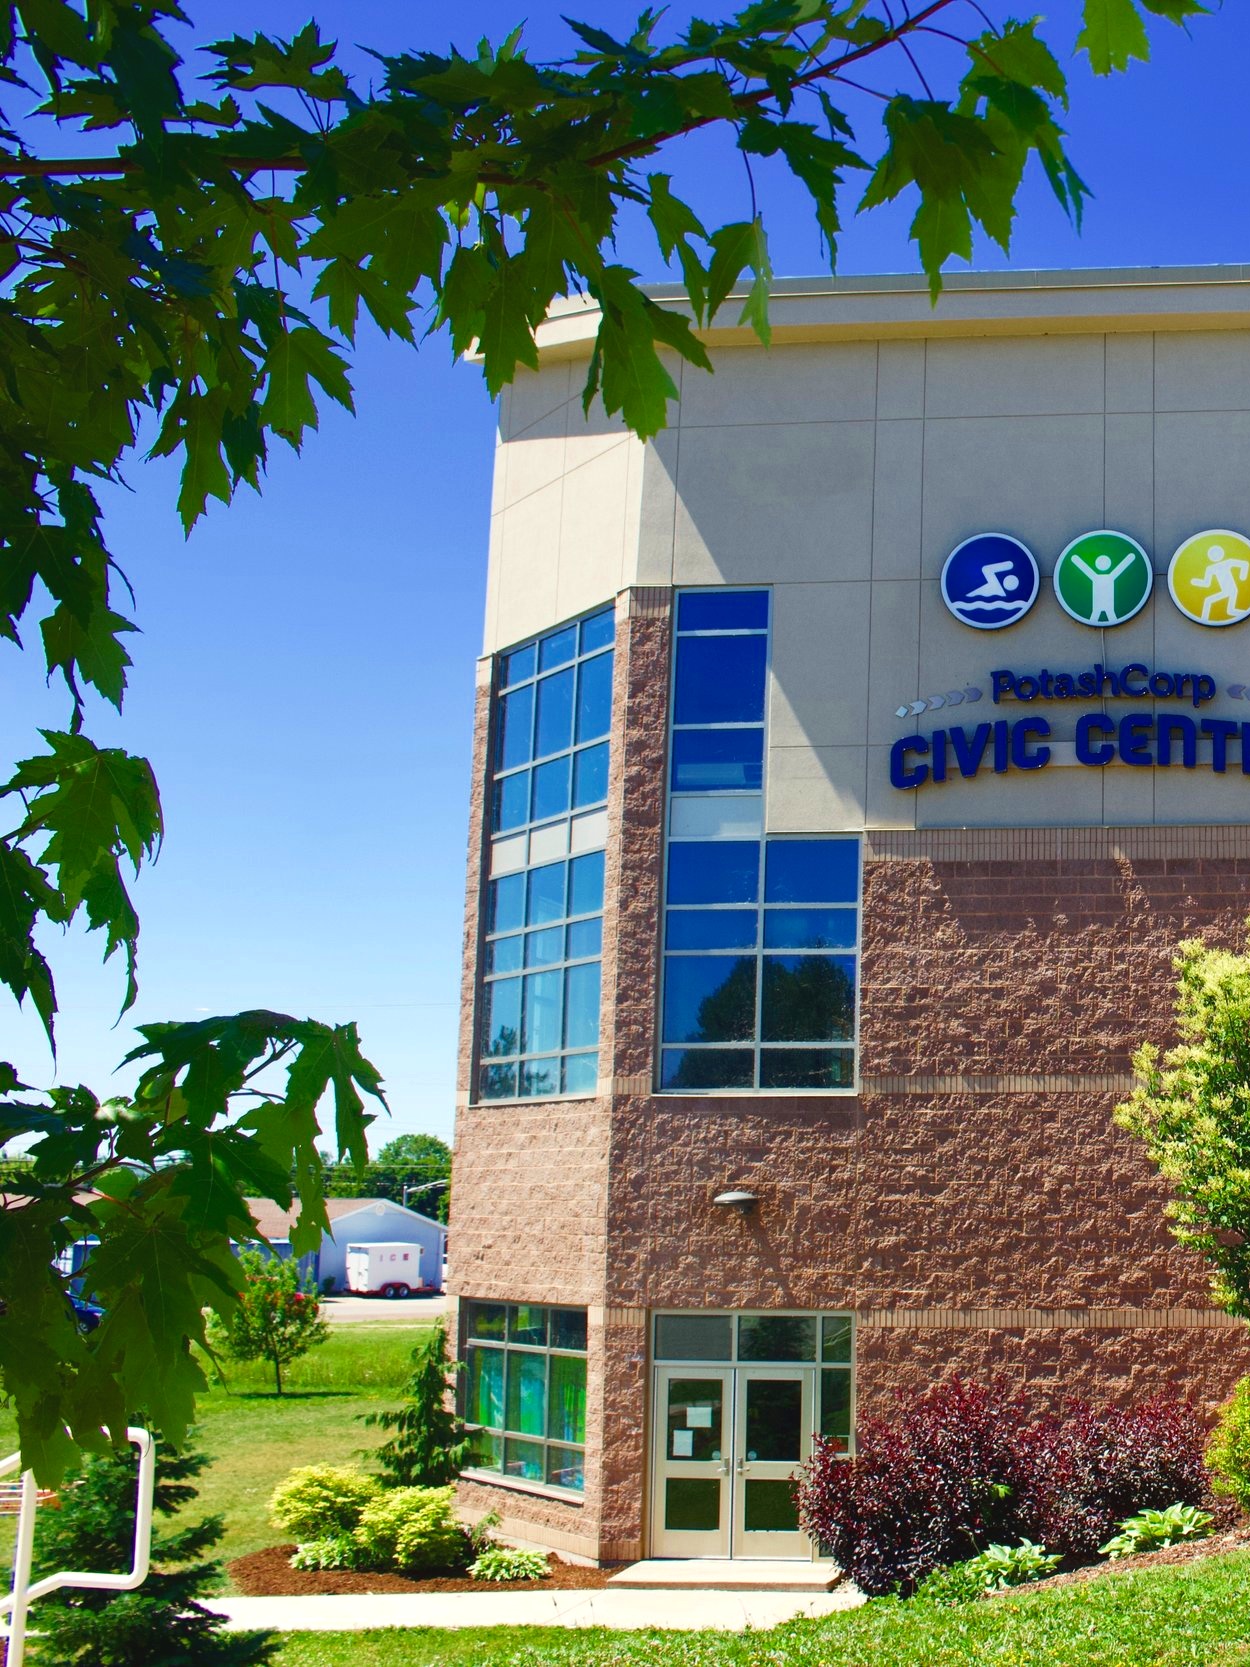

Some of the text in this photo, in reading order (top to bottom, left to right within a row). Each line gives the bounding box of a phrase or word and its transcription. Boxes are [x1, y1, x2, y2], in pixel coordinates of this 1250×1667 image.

[990, 664, 1216, 708] PotashCorp
[890, 717, 1051, 790] CIVIC
[380, 1253, 409, 1261] ICE
